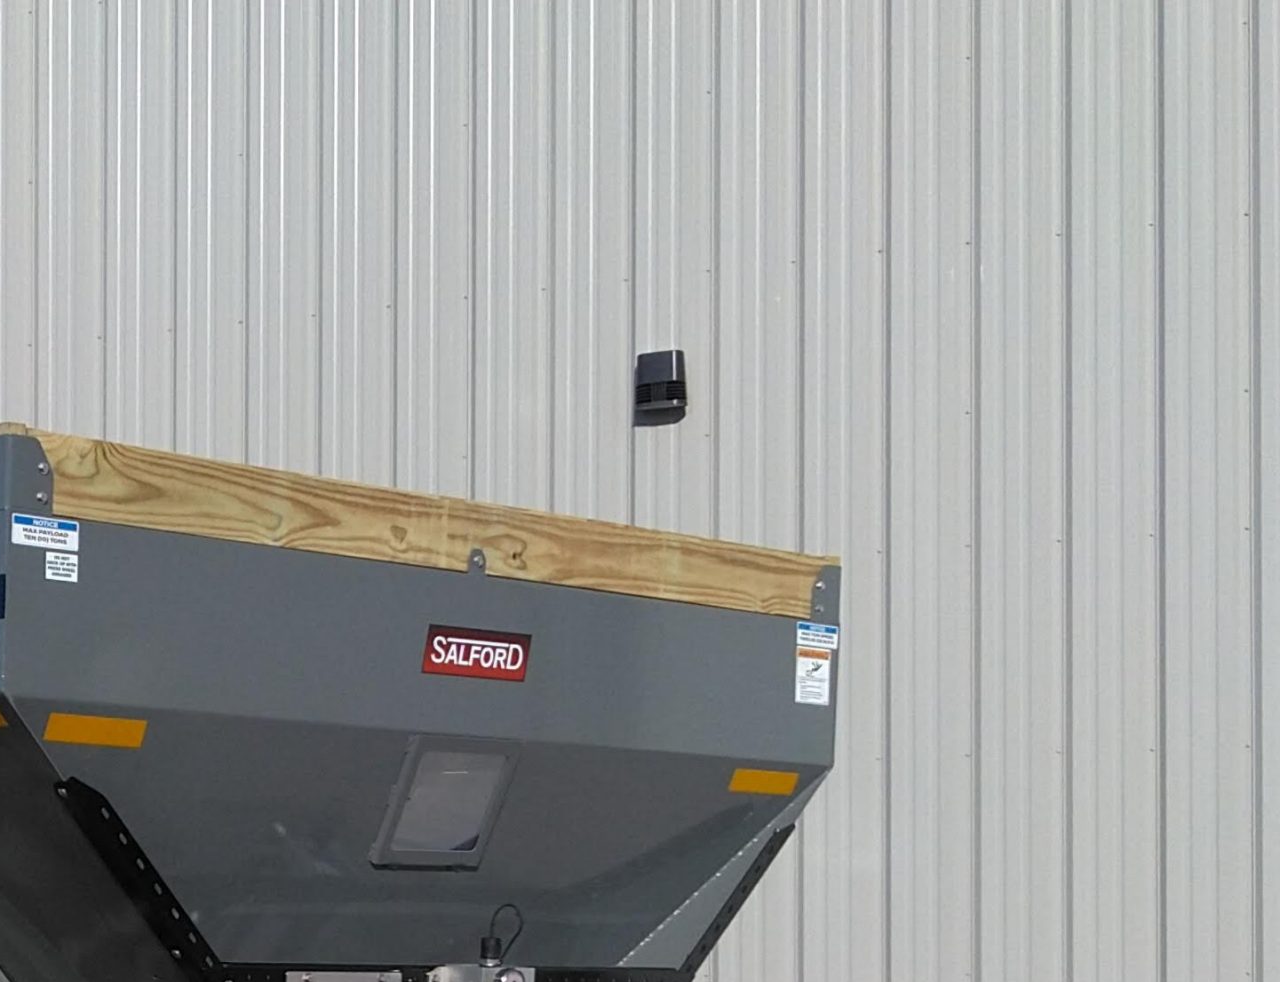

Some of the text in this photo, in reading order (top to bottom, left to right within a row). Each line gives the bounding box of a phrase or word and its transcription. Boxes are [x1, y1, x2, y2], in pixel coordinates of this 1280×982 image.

[32, 519, 59, 528] NOTICE
[38, 529, 69, 538] PAYLOAD
[50, 537, 68, 545] TONS
[430, 635, 524, 670] SALFORD
